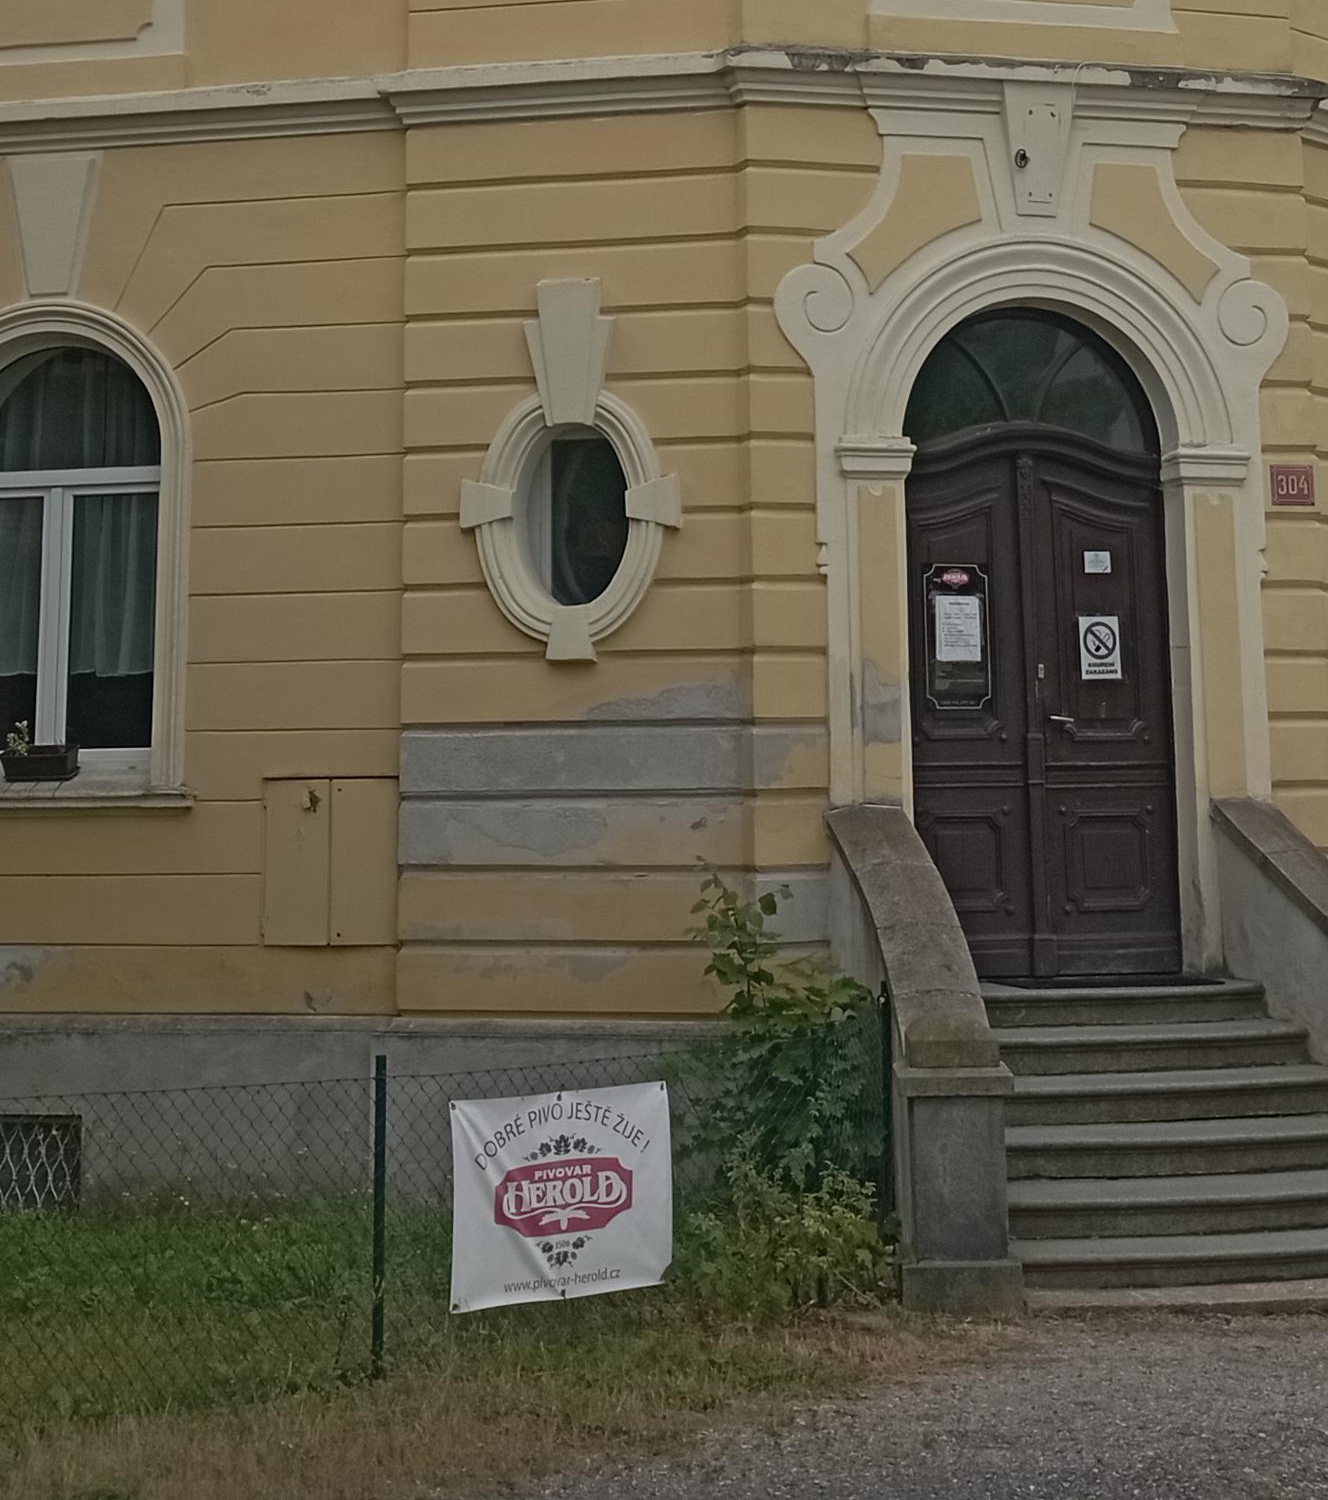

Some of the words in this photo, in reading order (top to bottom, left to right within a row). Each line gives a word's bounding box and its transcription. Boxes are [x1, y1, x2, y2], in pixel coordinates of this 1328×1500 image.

[1277, 475, 1308, 495] 304
[474, 1114, 525, 1171] DOBRÉ
[528, 1102, 563, 1128] PIVO
[567, 1100, 612, 1127] JEŠTĚ
[612, 1113, 645, 1148] ŽIJE
[534, 1164, 592, 1181] PIVOVAR
[503, 1170, 627, 1217] HEROLD
[503, 1267, 621, 1293] www.pivovar-herold.cz
